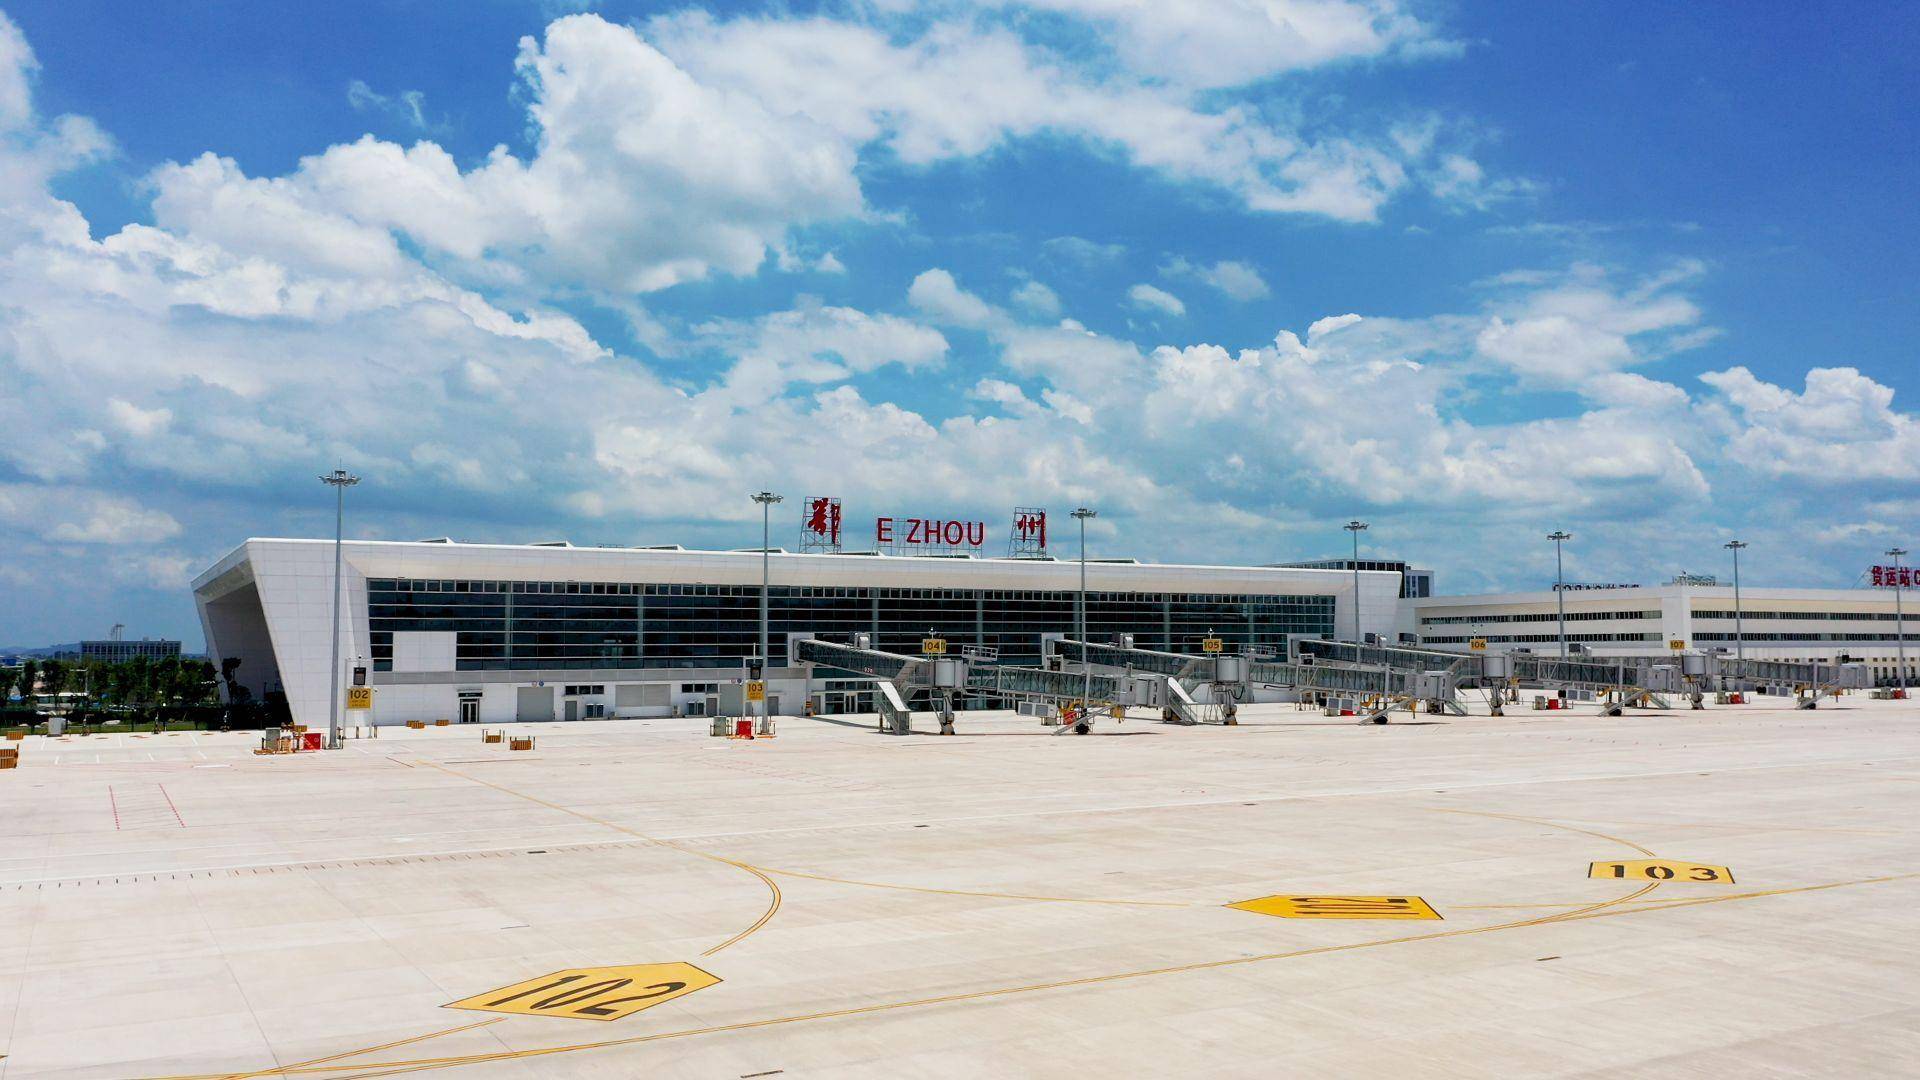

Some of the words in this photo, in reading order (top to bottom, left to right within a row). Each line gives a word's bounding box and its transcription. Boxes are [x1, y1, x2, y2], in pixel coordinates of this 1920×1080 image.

[808, 498, 841, 544] 鄂
[1017, 512, 1046, 548] 州
[924, 641, 940, 650] 104
[1204, 641, 1219, 649] 105
[1470, 641, 1486, 649] 106
[350, 690, 368, 699] 102
[1610, 865, 1718, 881] 103
[482, 974, 687, 1016] 102
